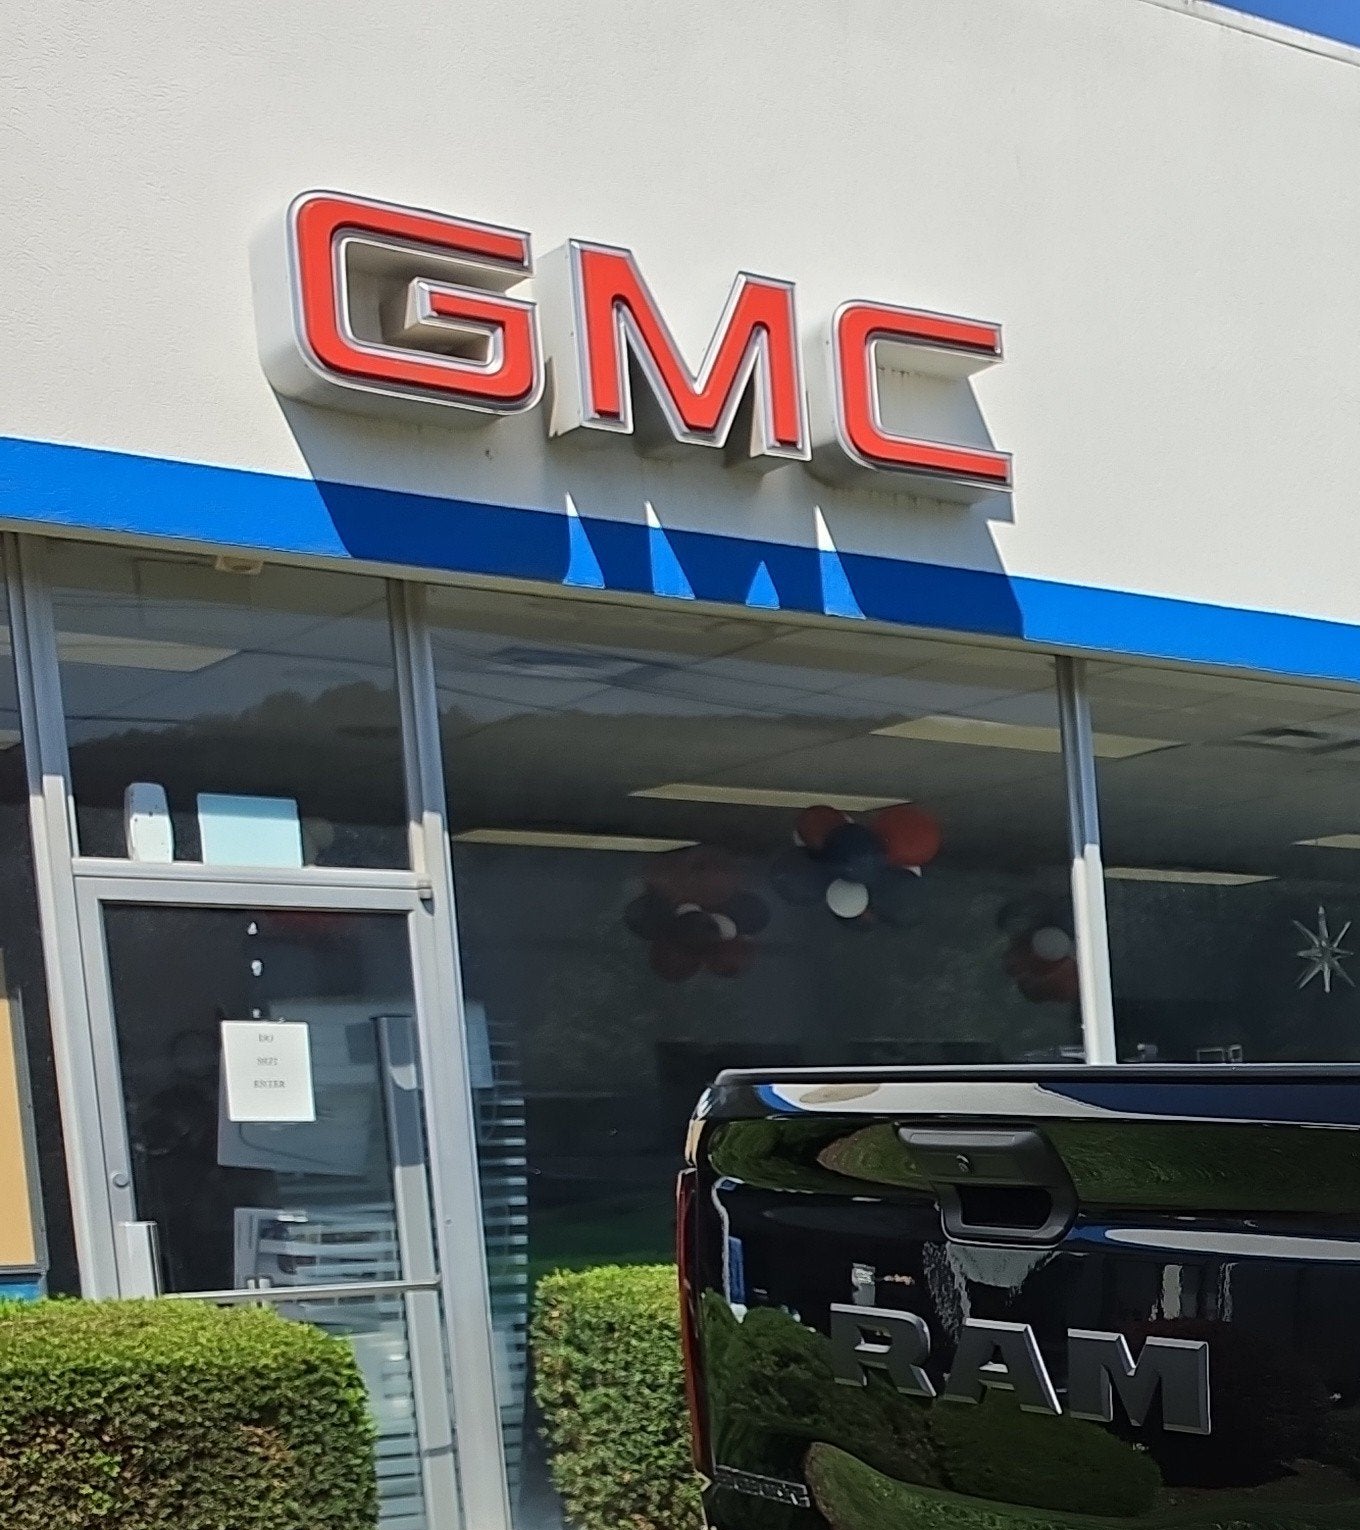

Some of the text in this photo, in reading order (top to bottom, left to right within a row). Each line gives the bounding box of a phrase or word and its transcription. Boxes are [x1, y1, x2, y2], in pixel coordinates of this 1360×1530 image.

[284, 189, 1014, 489] GMC
[253, 1080, 286, 1089] ENTER
[829, 1302, 1212, 1435] RAM
